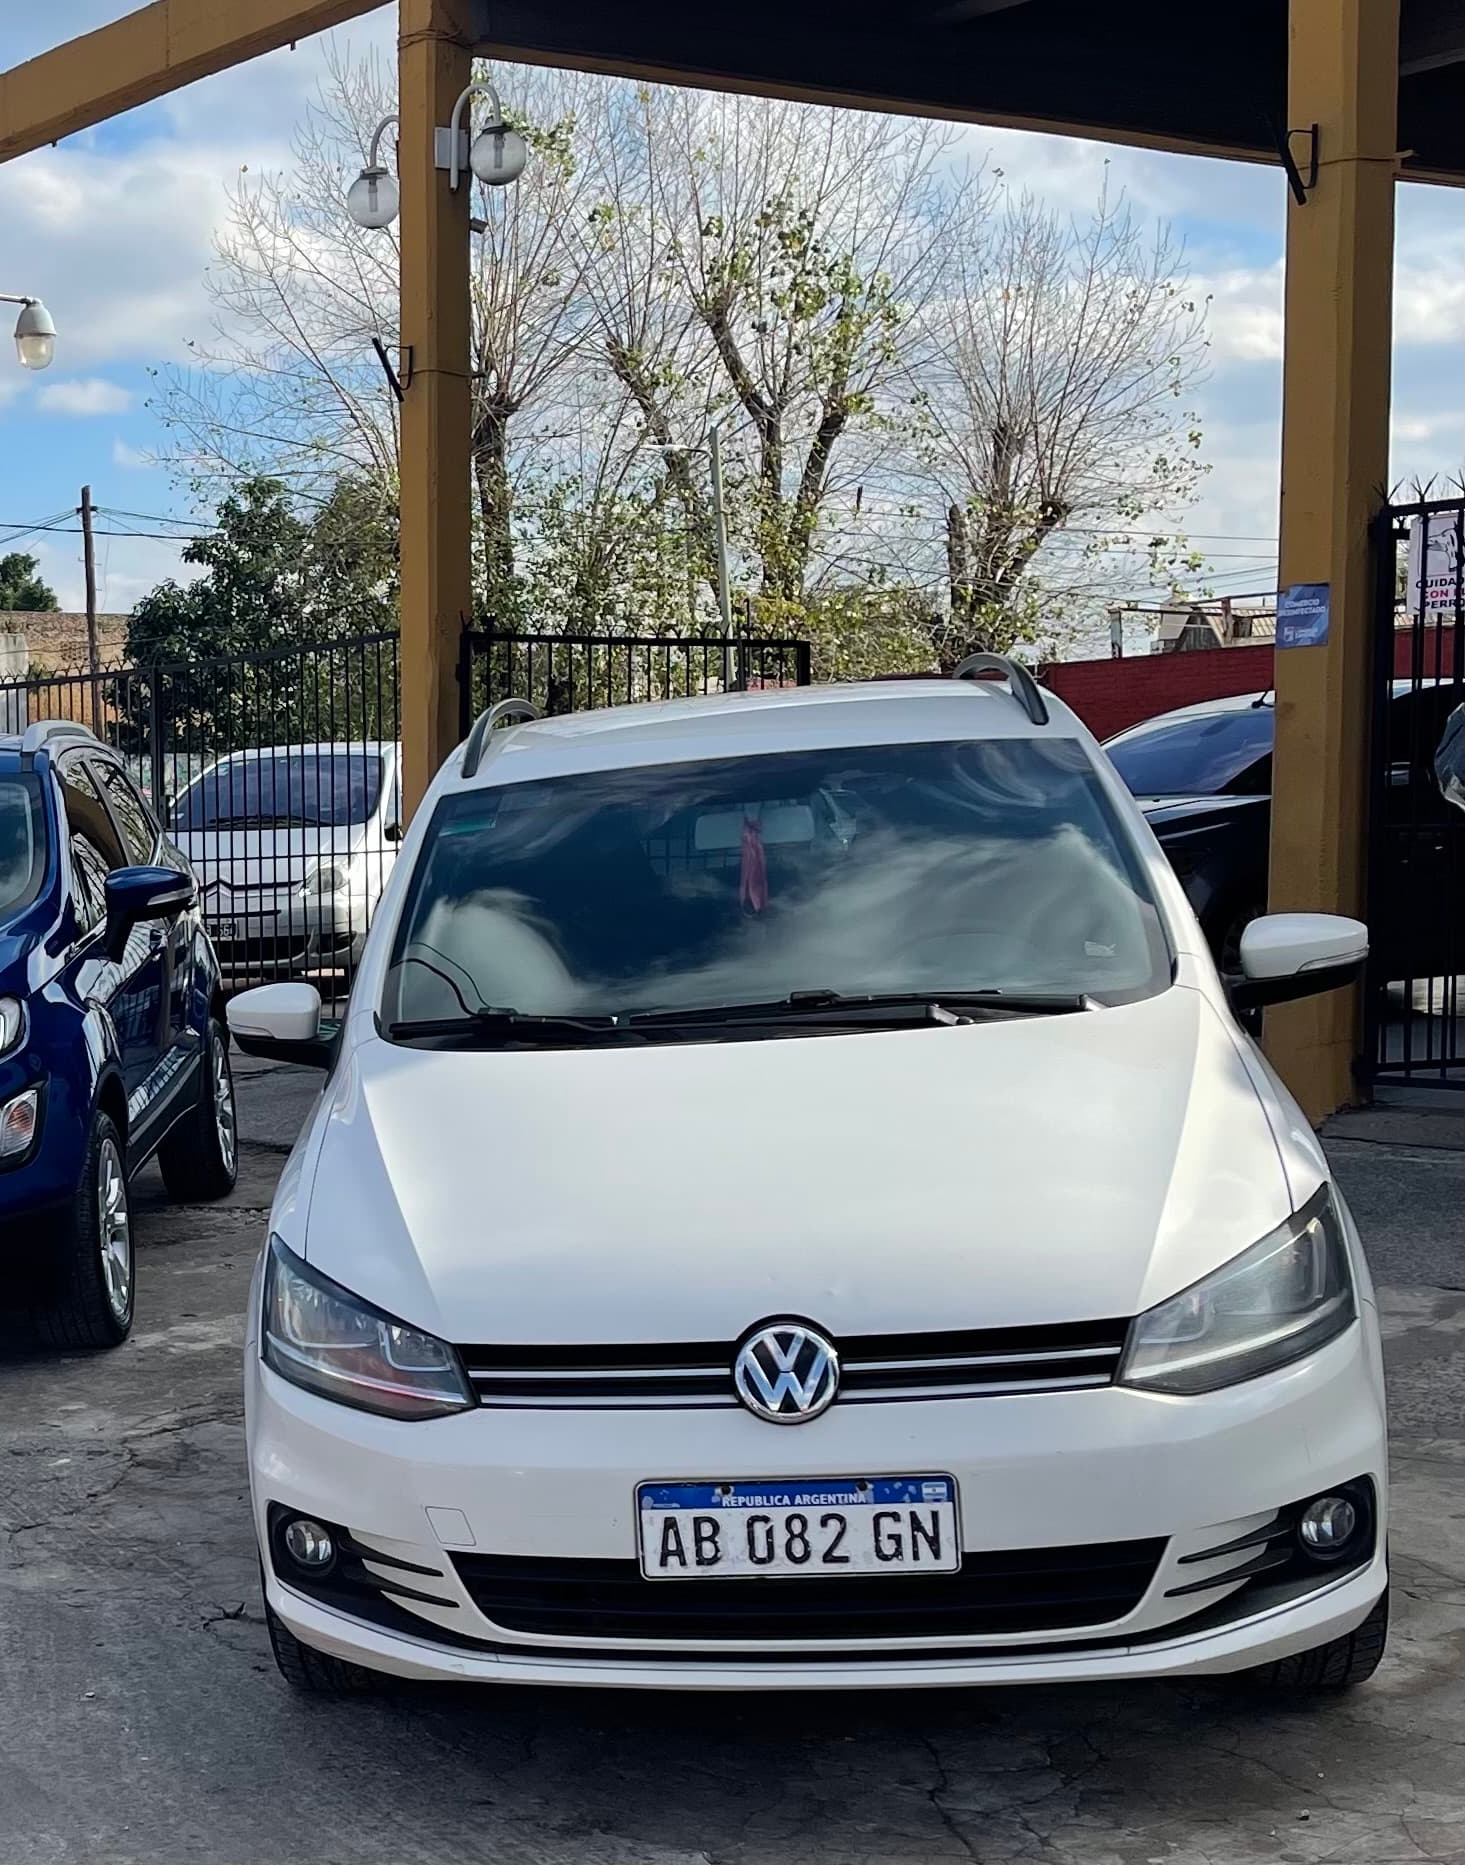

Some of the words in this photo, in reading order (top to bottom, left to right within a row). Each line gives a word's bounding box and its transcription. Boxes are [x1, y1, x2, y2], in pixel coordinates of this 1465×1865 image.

[722, 1494, 792, 1507] REPUBLICA
[794, 1492, 866, 1505] ARGENTINA
[659, 1516, 723, 1567] AB
[747, 1513, 851, 1565] 082
[873, 1510, 942, 1561] GN
